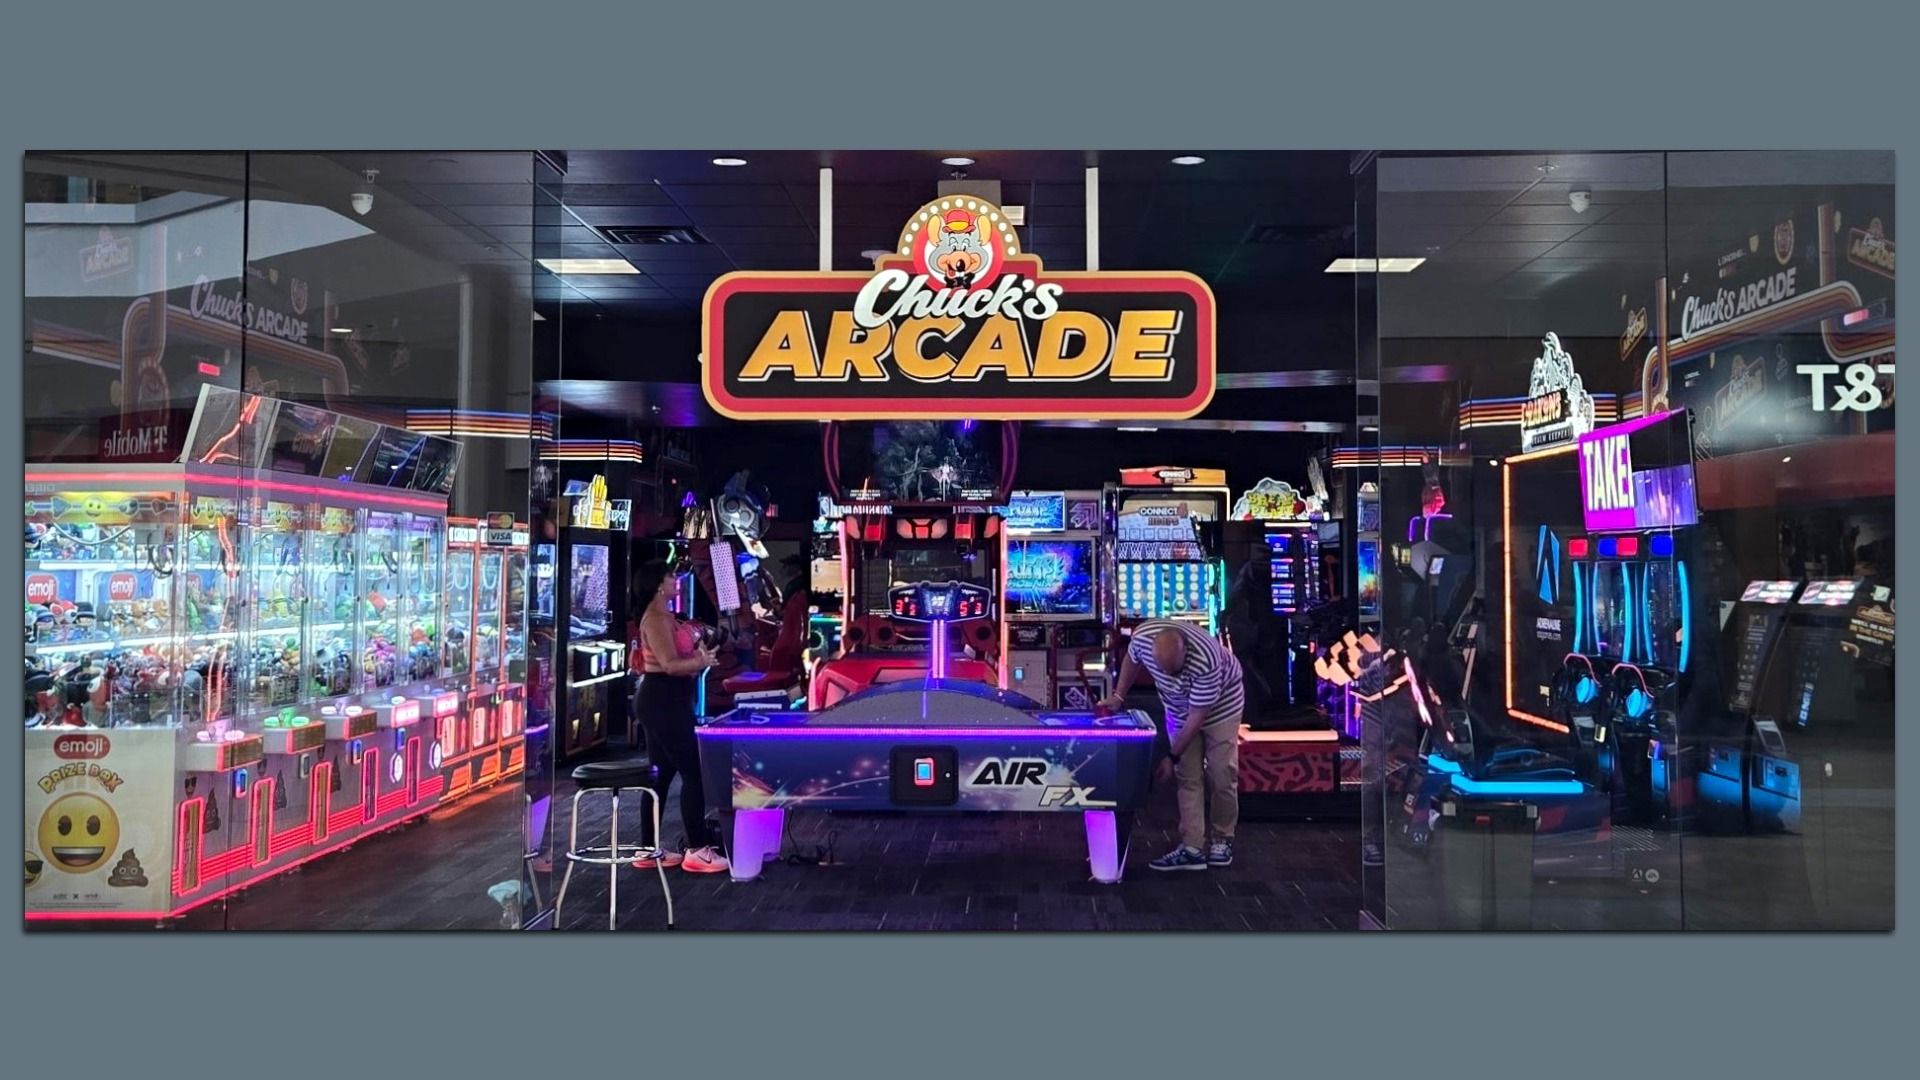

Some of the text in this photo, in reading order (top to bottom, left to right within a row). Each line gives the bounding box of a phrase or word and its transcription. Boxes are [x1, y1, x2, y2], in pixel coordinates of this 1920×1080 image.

[853, 269, 1063, 328] Chuck's
[1681, 267, 1797, 341] Chuck's ARCADE
[256, 307, 308, 345] ARCADE
[737, 310, 1184, 383] ARCADE
[1140, 506, 1178, 516] CONNECT
[491, 532, 512, 540] VISA
[27, 580, 54, 598] emoji
[111, 577, 134, 595] emoji
[60, 738, 103, 756] emoji
[38, 762, 124, 793] PRIZE BOX
[972, 762, 1047, 785] AIR
[1039, 786, 1110, 806] FX
